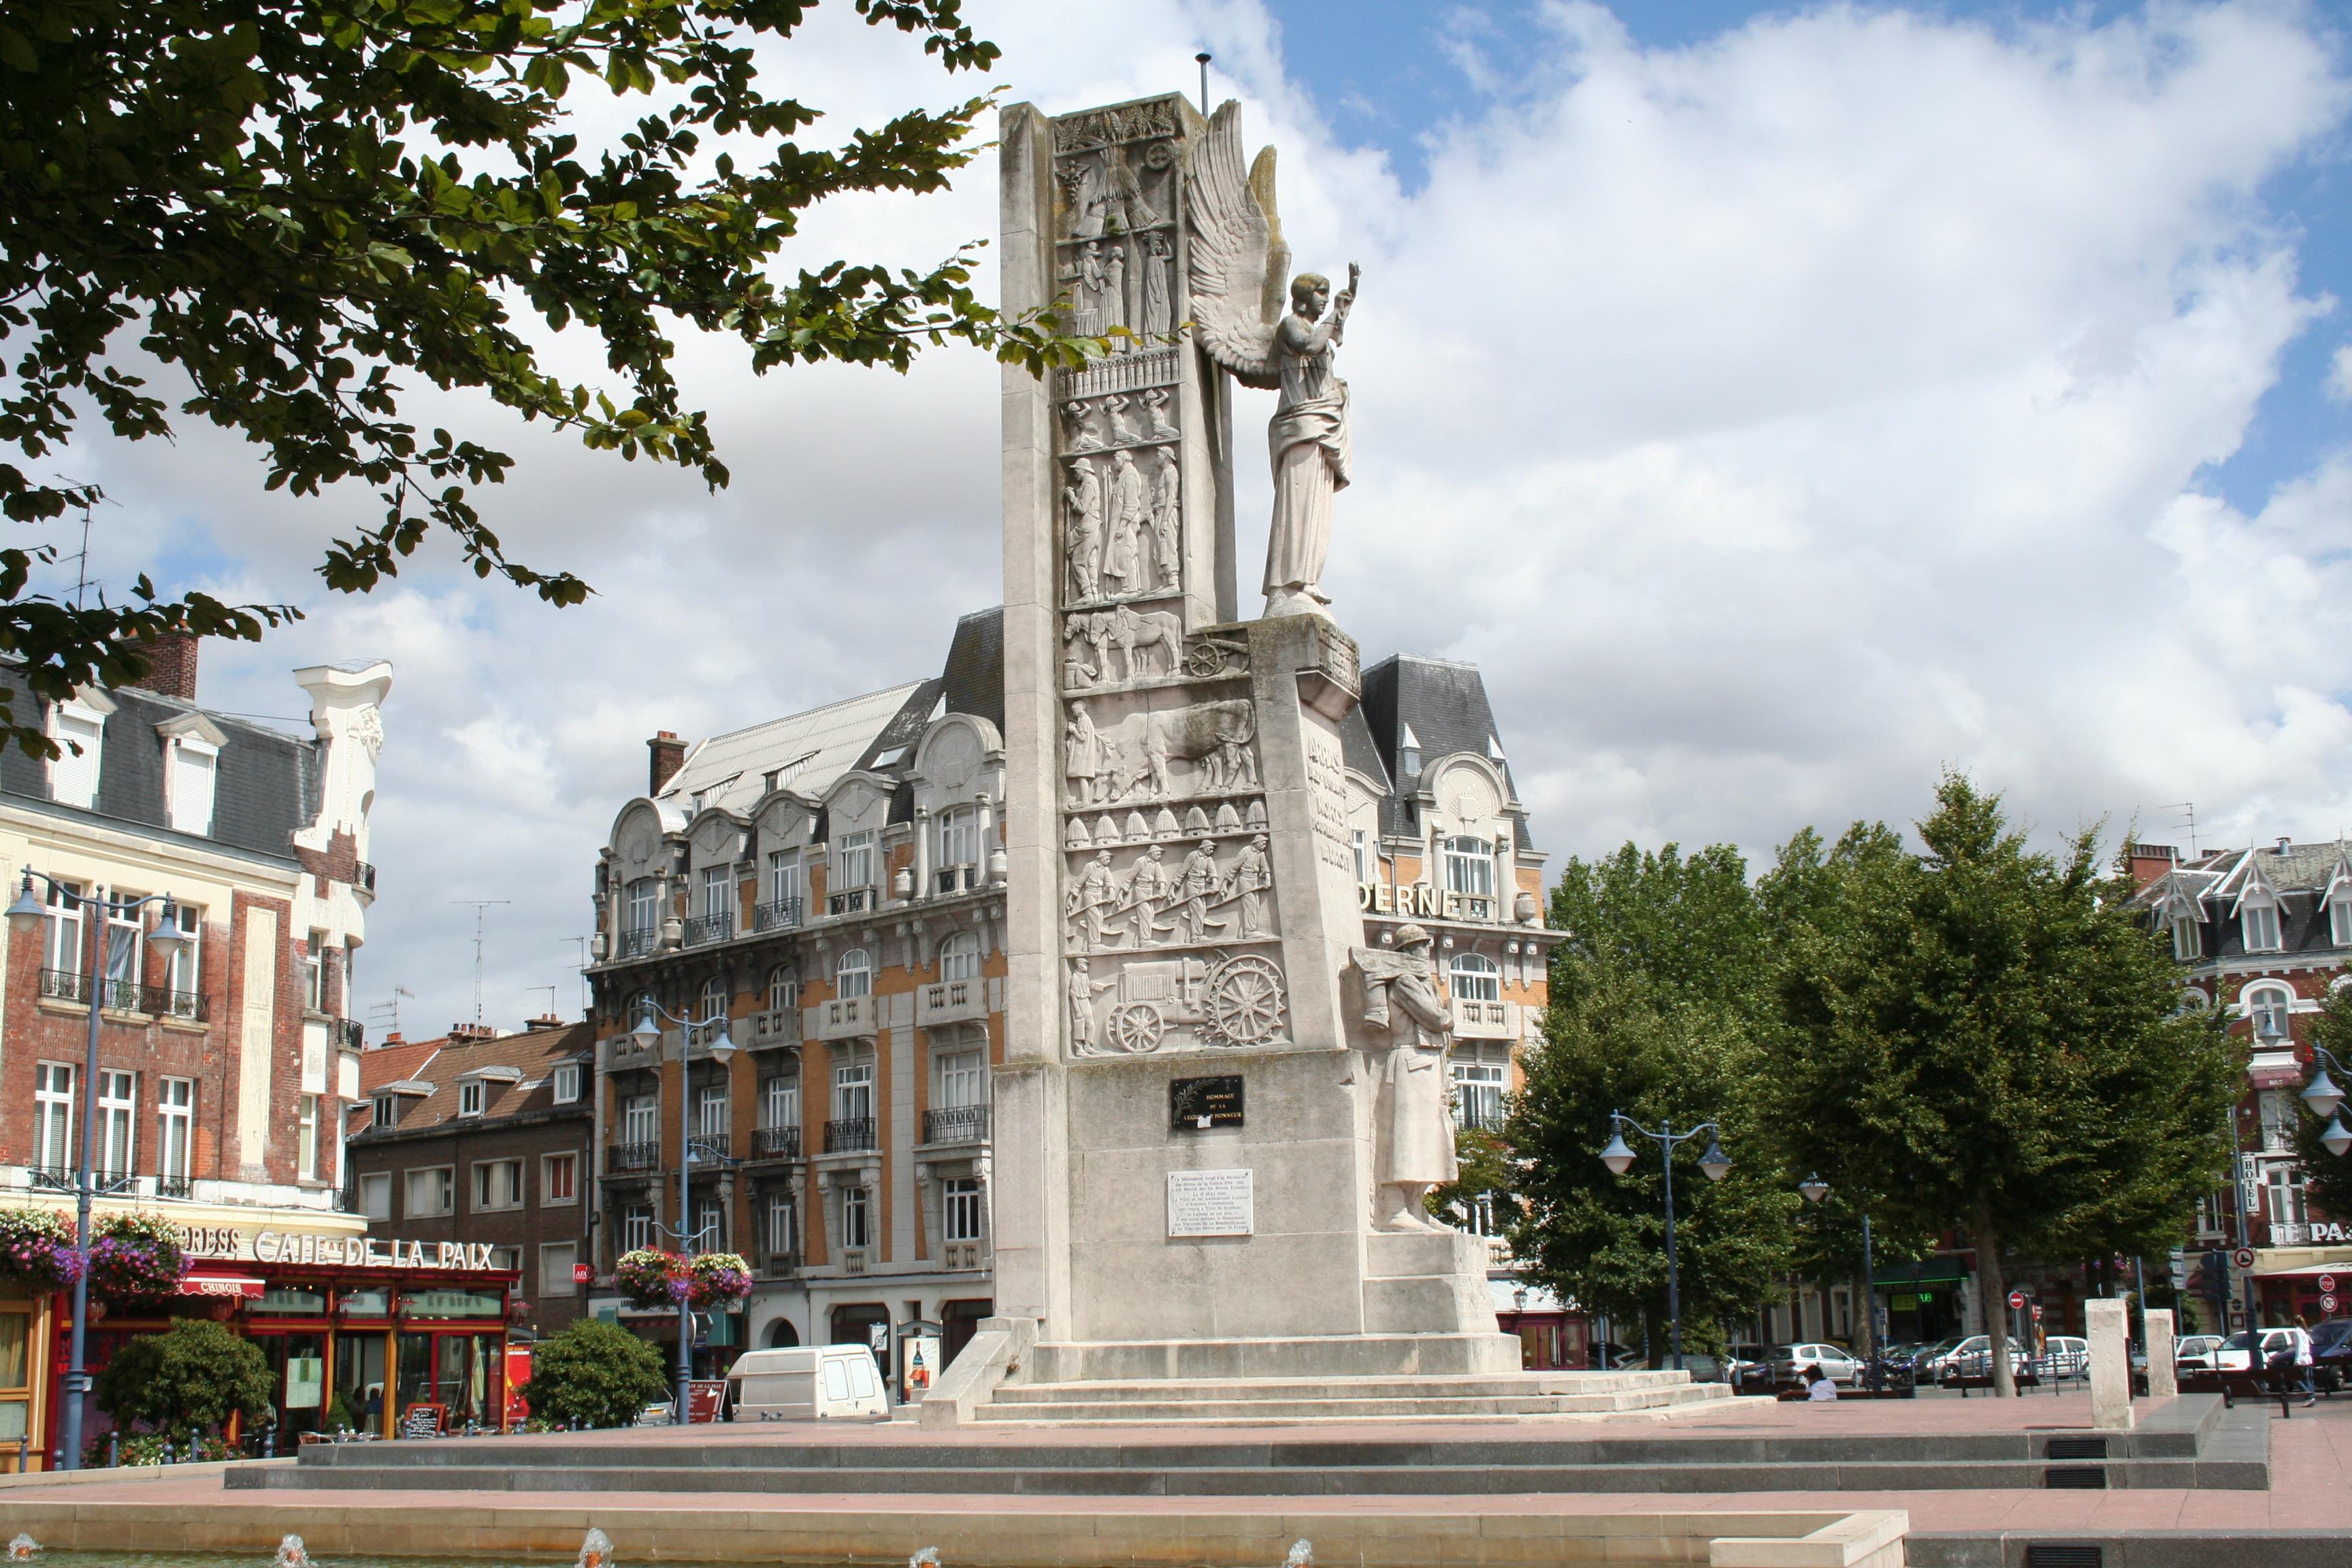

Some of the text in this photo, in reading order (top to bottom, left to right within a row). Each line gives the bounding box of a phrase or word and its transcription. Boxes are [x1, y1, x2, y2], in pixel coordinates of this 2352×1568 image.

[2245, 1161, 2256, 1207] HOTEL
[2269, 1224, 2300, 1243] LE
[253, 1230, 495, 1271] CAFE DE LA PAIX
[200, 1282, 242, 1293] CHINOIS
